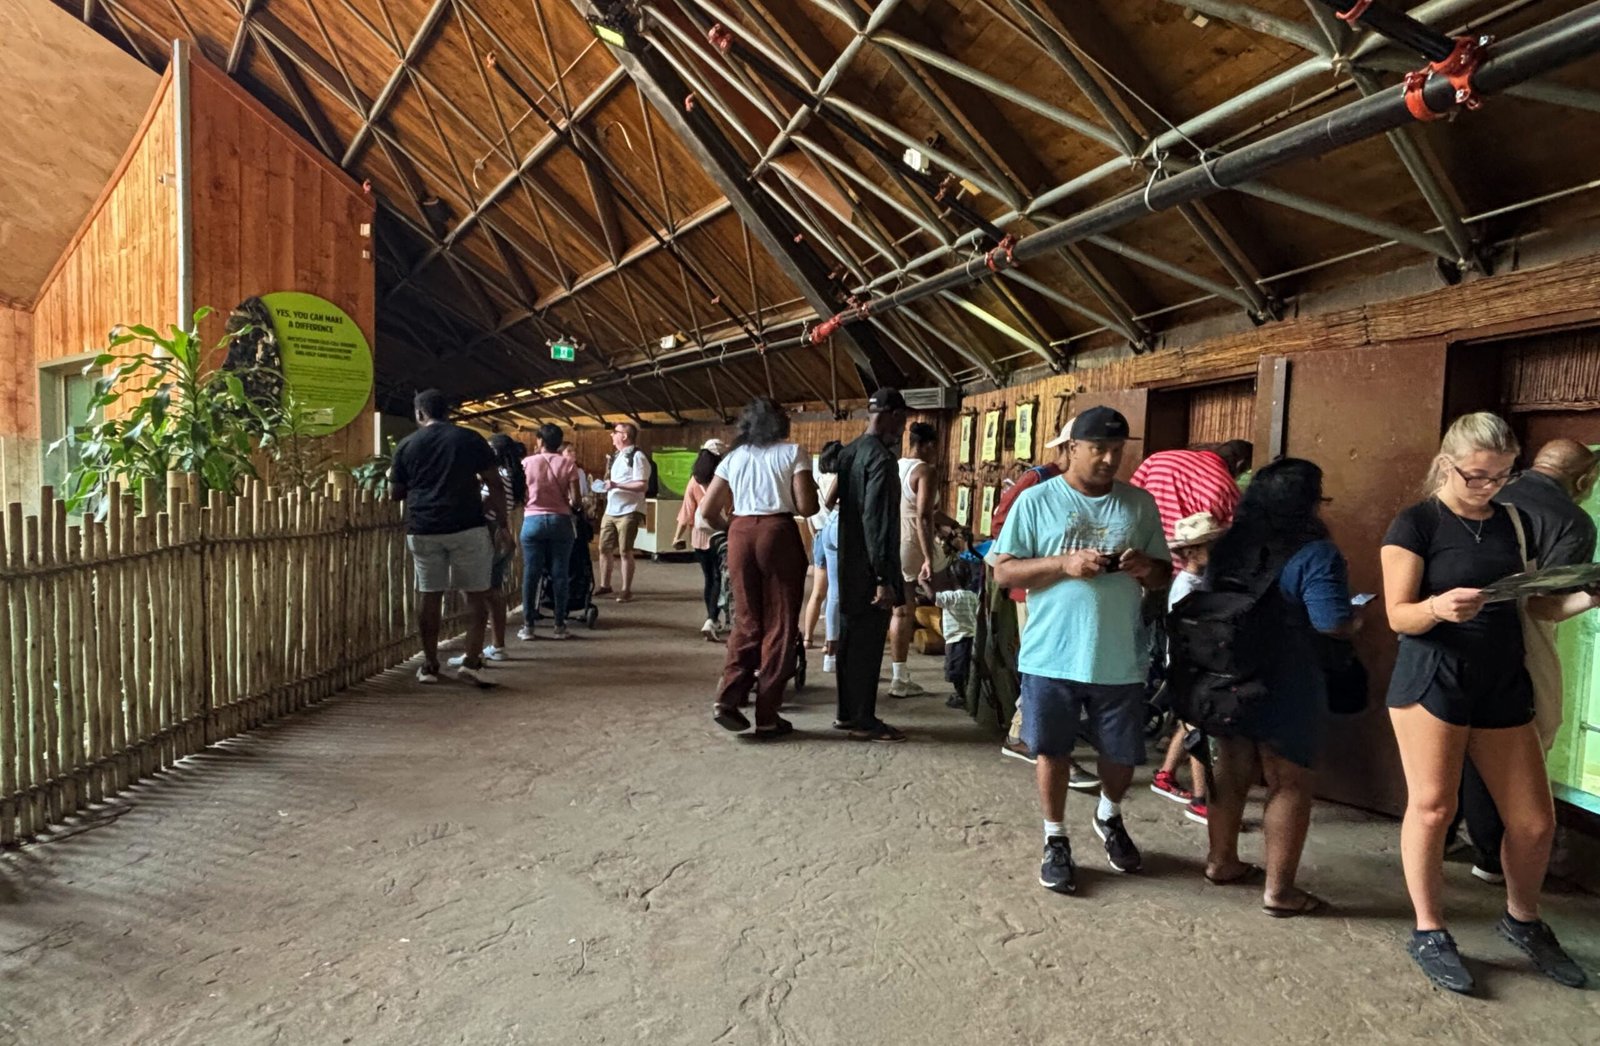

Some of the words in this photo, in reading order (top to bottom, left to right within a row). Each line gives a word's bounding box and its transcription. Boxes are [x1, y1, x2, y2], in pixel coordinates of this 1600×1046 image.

[293, 311, 308, 320] YOU
[310, 313, 324, 321] CAN
[325, 315, 343, 324] MAKE
[288, 320, 293, 328] A
[295, 321, 333, 333] DIFFERENCE
